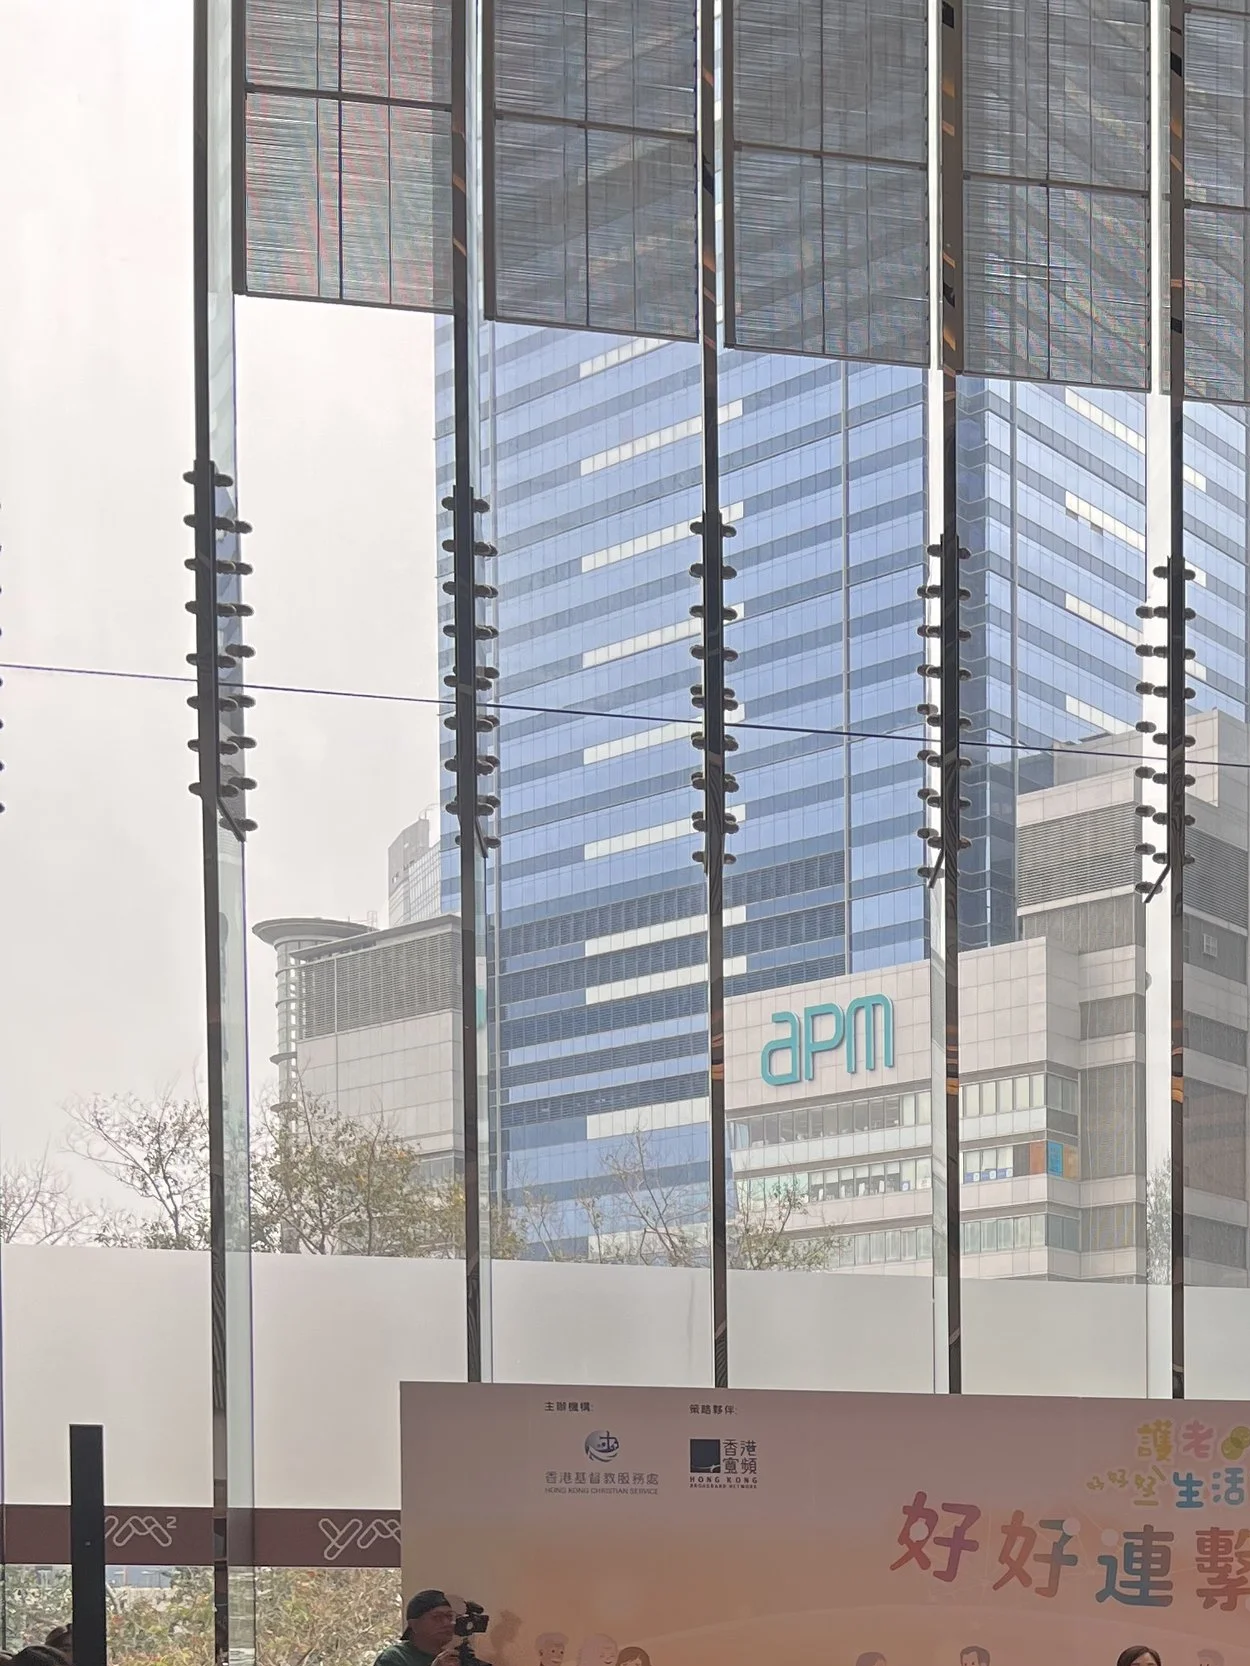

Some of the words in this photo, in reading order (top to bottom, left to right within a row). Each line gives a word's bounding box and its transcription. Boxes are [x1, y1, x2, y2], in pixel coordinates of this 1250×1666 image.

[545, 1472, 659, 1486] 香港基督教服務處
